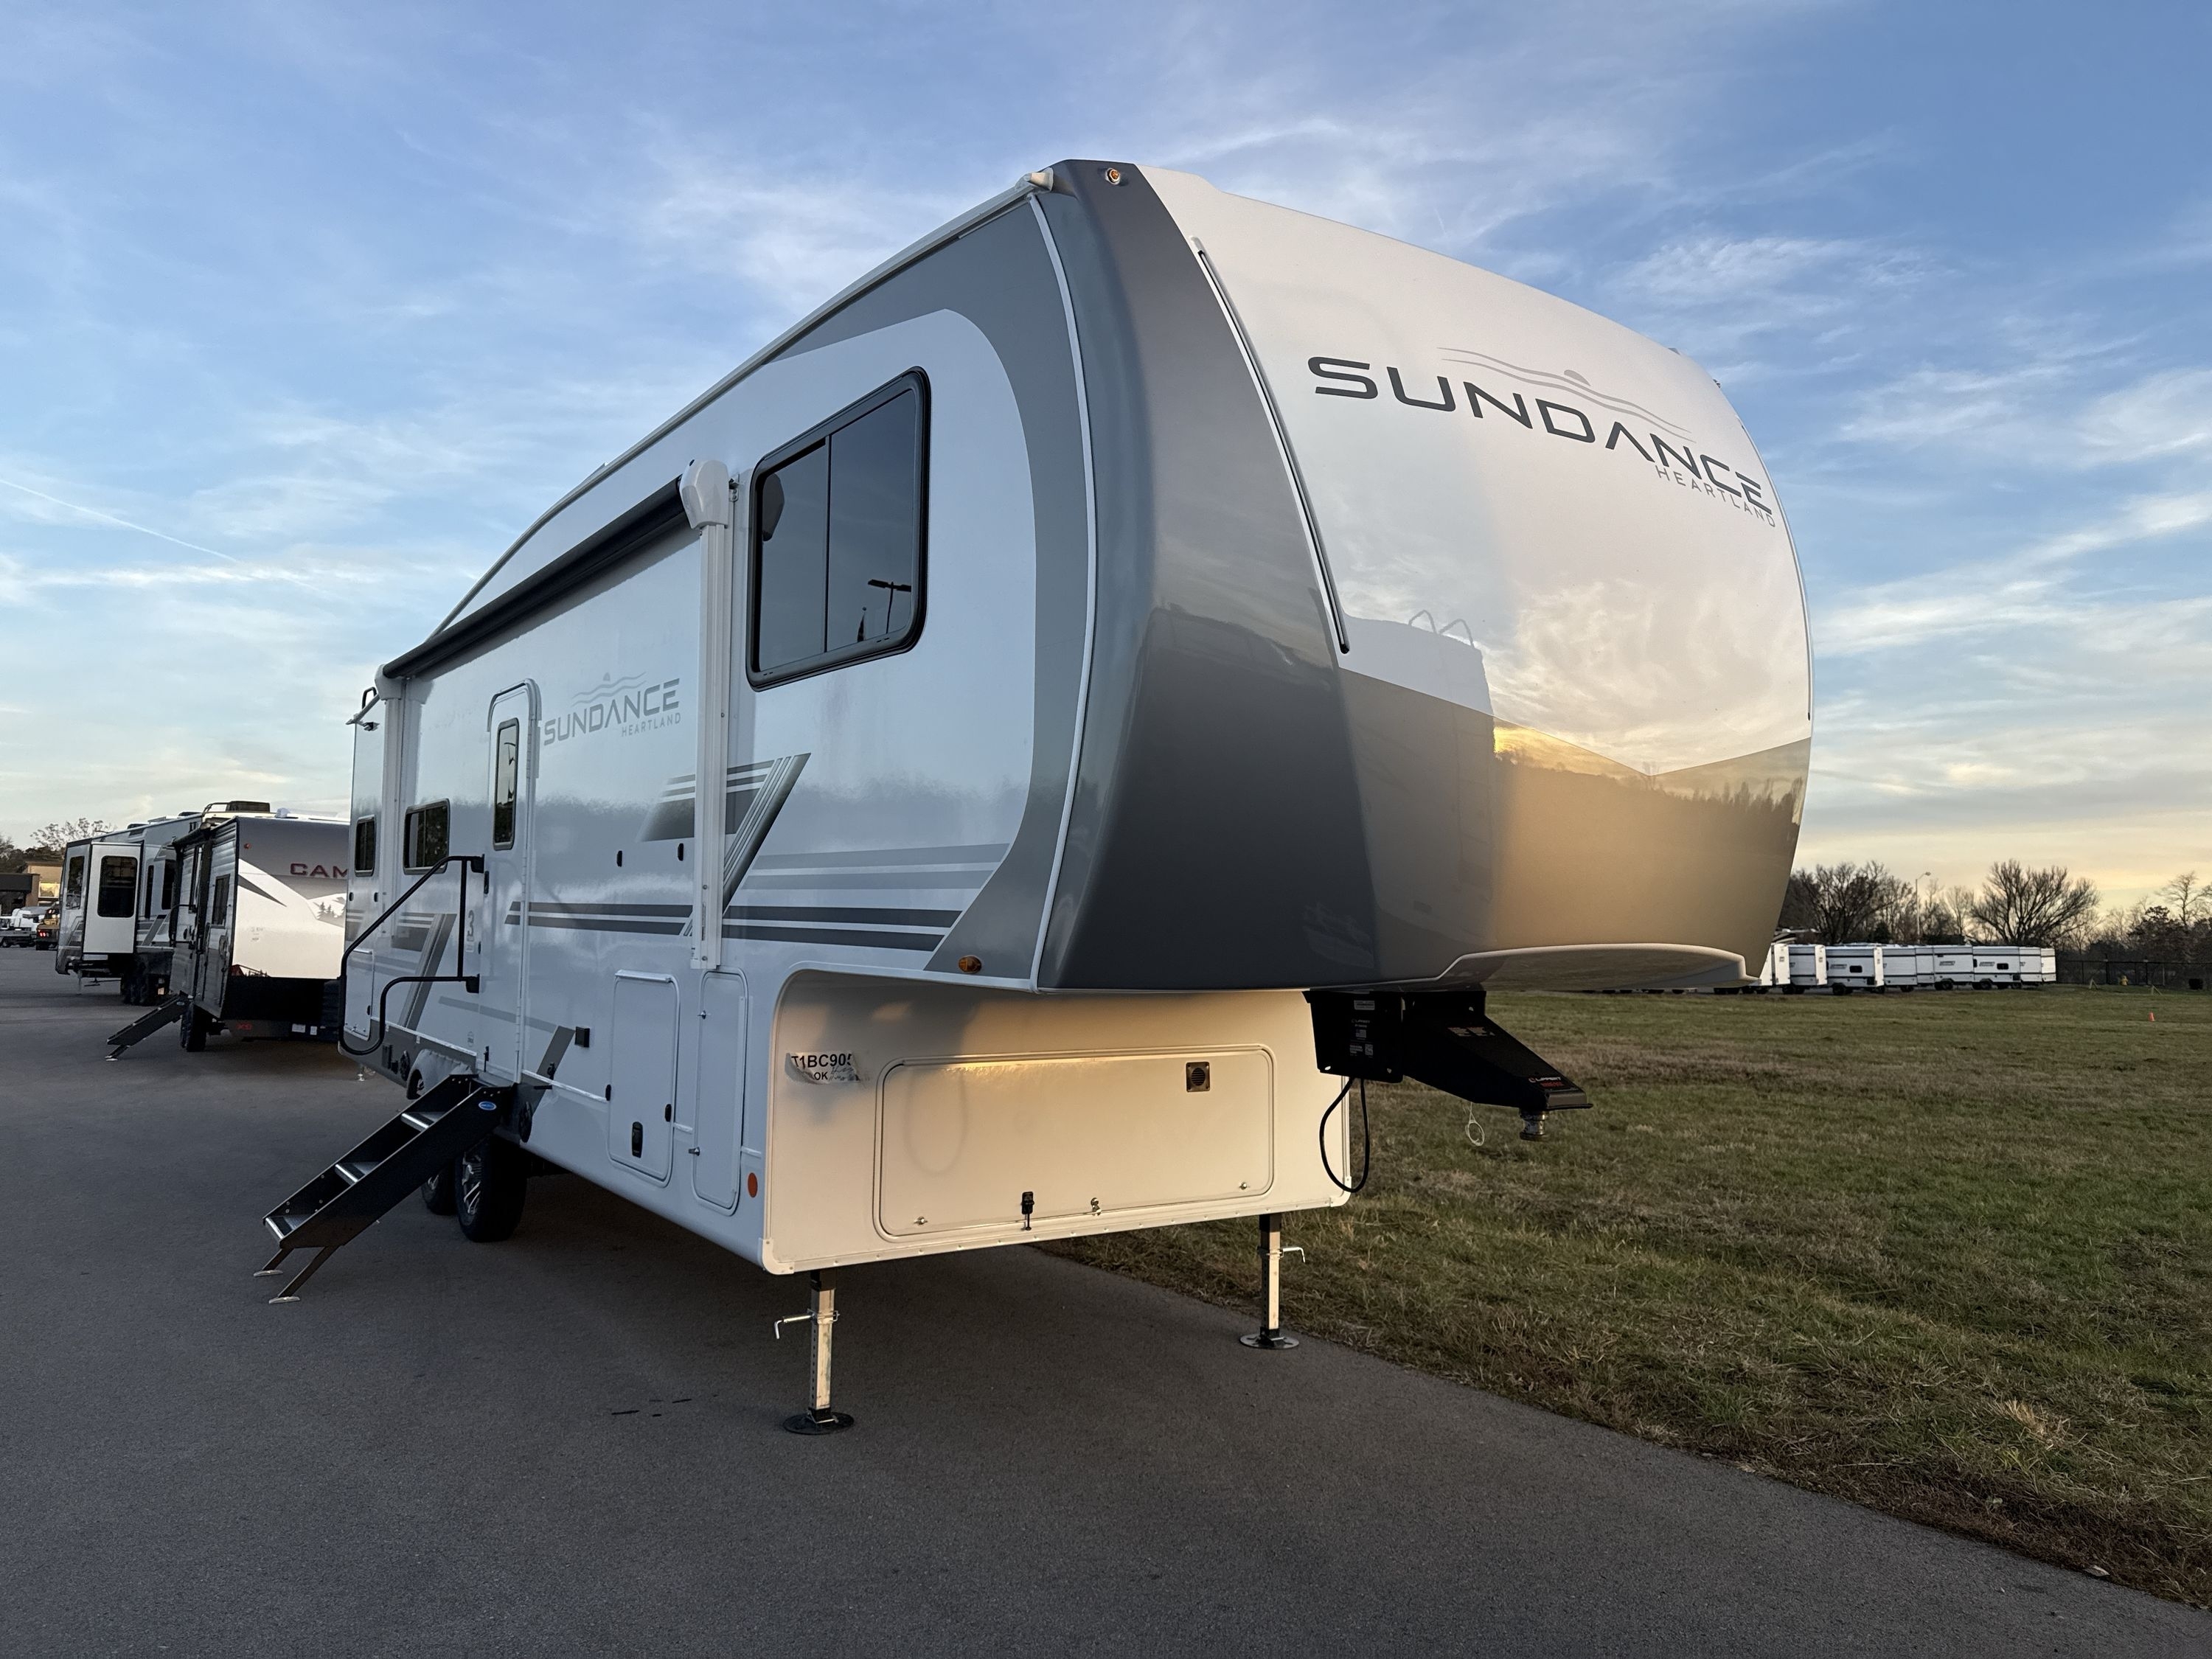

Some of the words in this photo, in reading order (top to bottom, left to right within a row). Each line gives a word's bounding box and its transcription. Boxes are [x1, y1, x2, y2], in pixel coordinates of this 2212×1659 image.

[1308, 357, 1772, 515] SUNDANCE
[1655, 465, 1775, 527] HEARTLAND
[544, 678, 680, 745] SUNDANCE
[622, 712, 681, 737] HEARTLAND
[813, 1071, 828, 1080] OK
